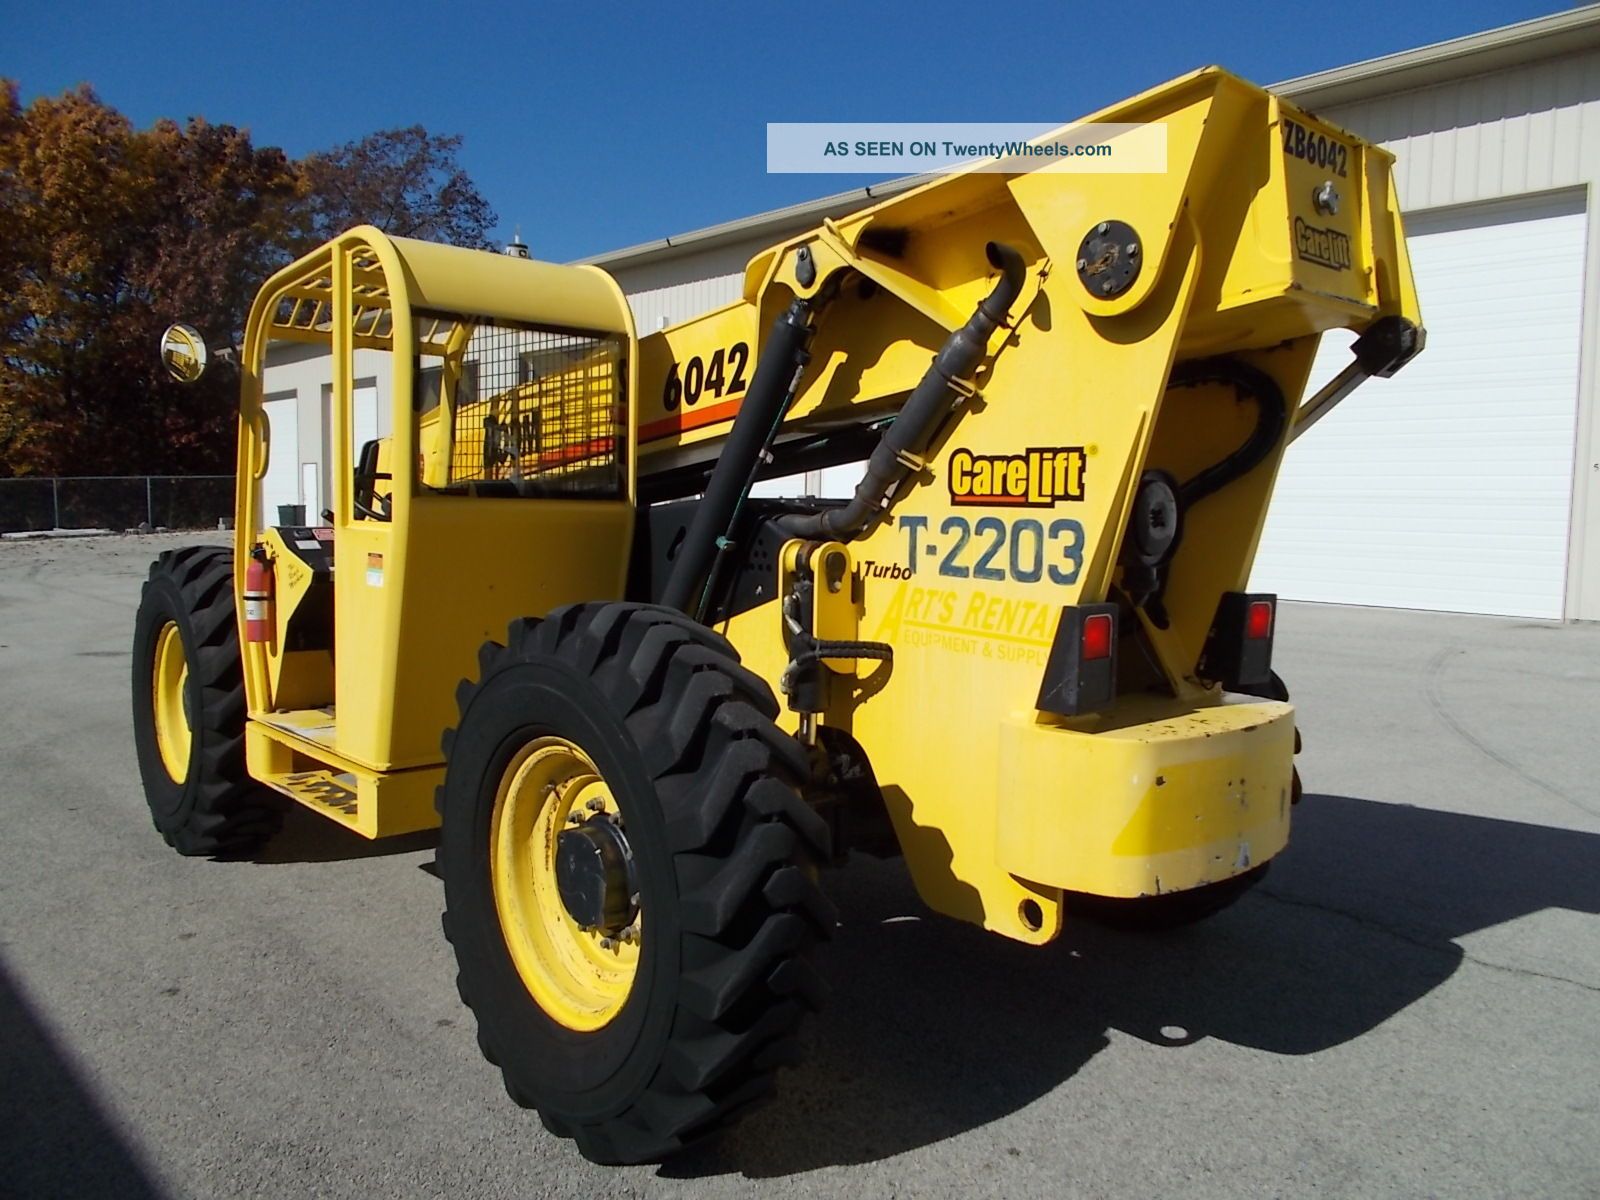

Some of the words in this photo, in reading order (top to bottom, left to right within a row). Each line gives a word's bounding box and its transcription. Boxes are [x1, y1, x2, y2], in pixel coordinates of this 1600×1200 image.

[1283, 118, 1347, 178] ZB6042
[1295, 216, 1350, 271] CareLift
[663, 342, 749, 412] 6042
[949, 447, 1086, 508] CareLift
[864, 560, 912, 581] Turbo
[899, 515, 1085, 586] T-2203
[872, 581, 959, 645] ART'S
[903, 631, 977, 655] EQUIPMENT
[981, 641, 993, 658] &
